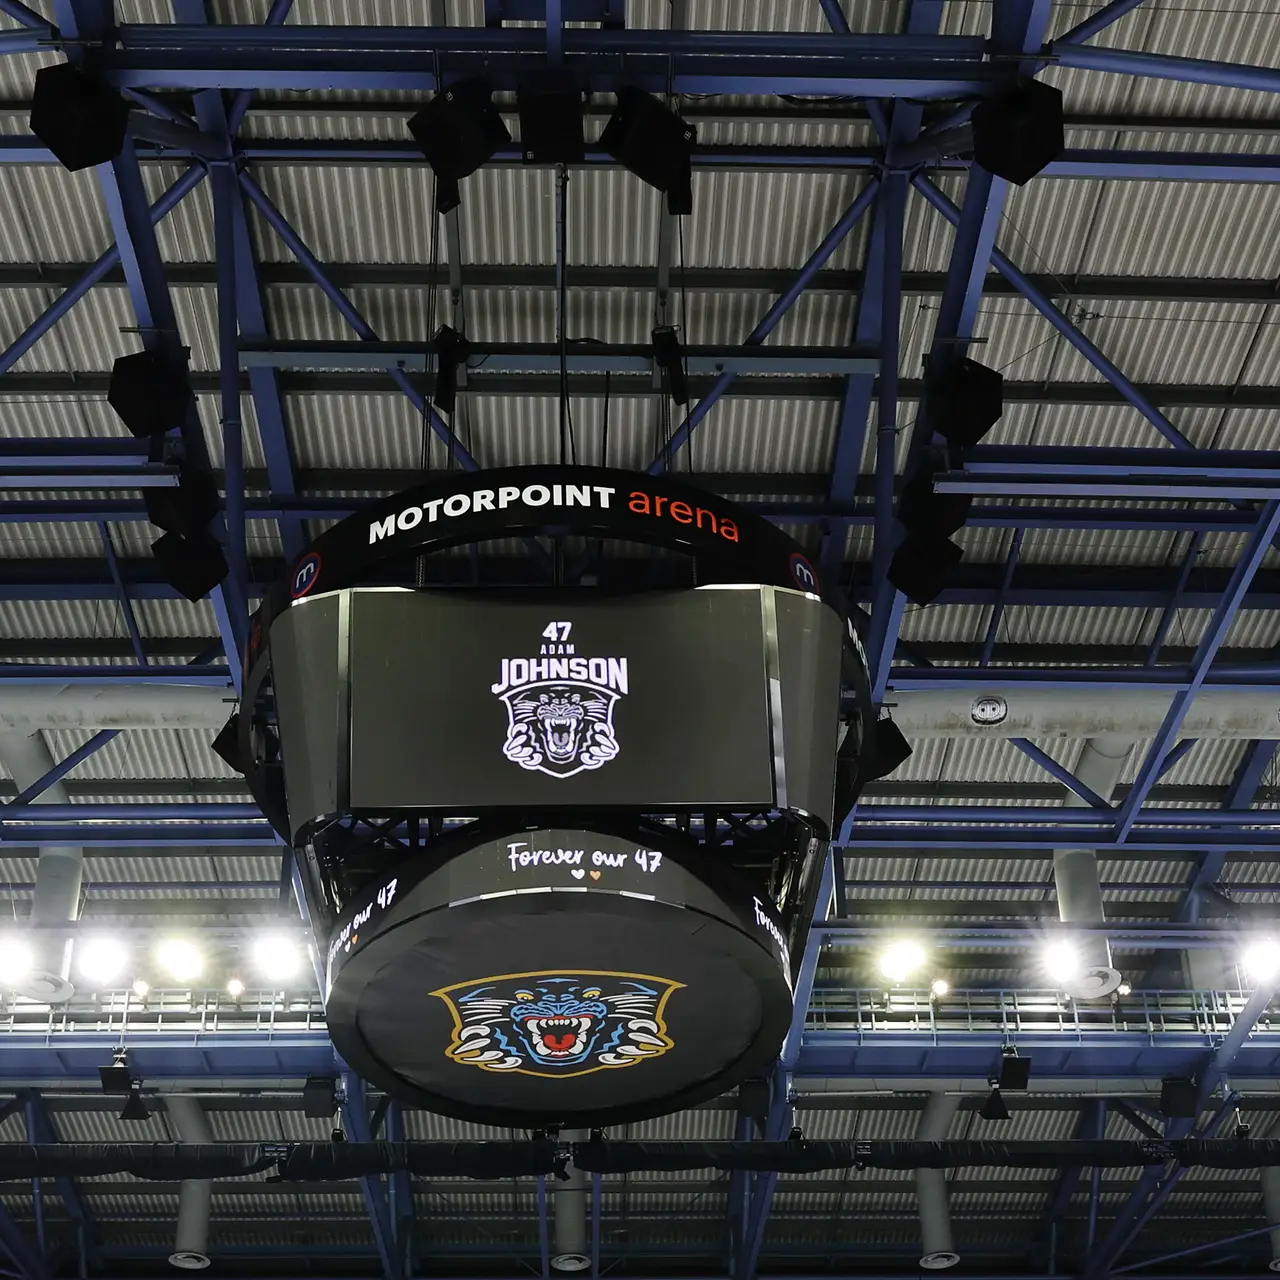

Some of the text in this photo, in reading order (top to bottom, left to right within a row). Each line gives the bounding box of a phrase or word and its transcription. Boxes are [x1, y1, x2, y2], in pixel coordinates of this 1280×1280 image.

[369, 484, 739, 544] MOTORPOINT arena
[542, 621, 572, 642] 47
[540, 644, 576, 655] ADAM
[491, 656, 628, 696] JOHNSON
[507, 842, 663, 873] Forever our 47
[353, 878, 397, 930] our 47
